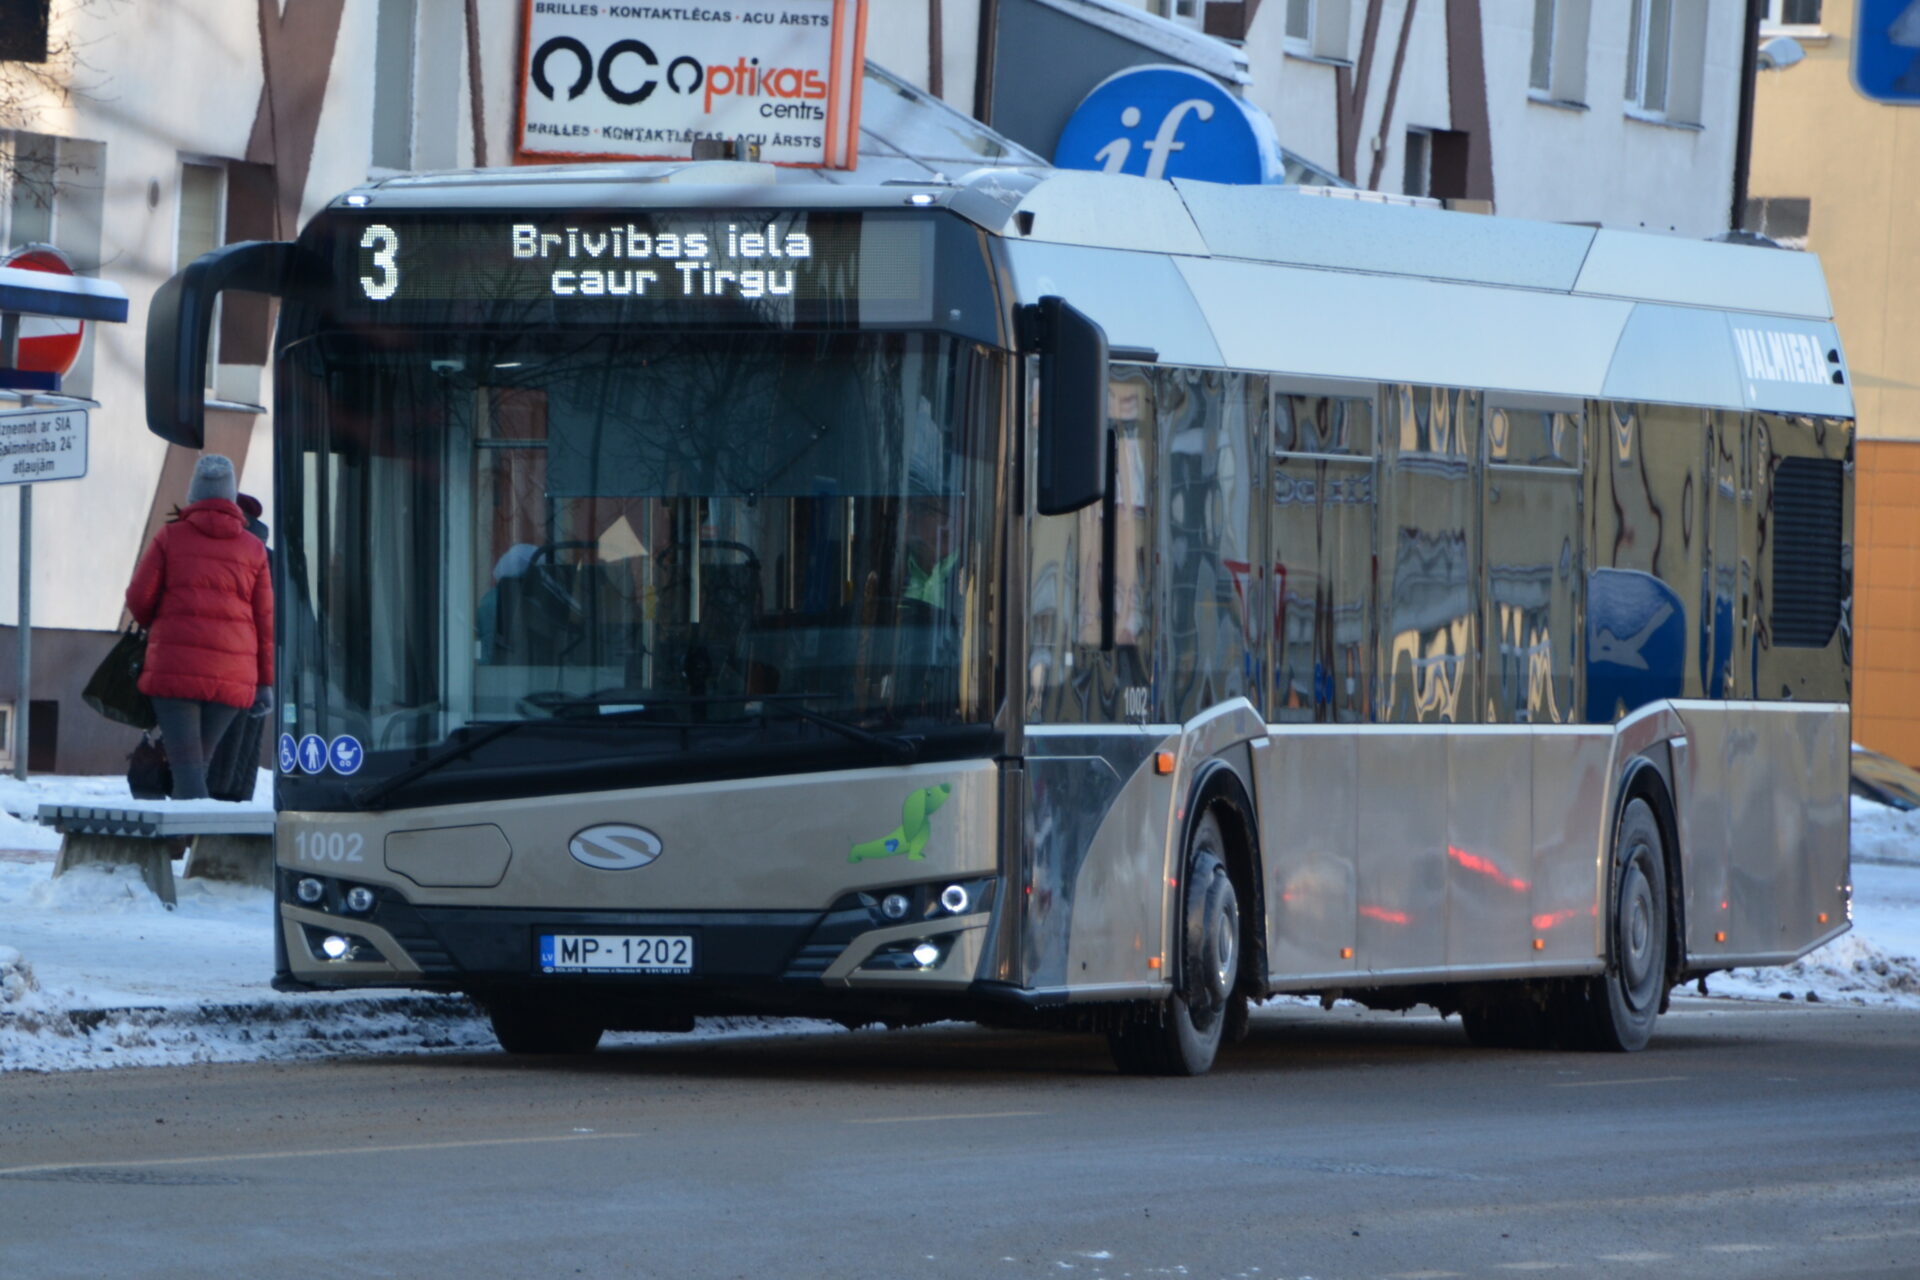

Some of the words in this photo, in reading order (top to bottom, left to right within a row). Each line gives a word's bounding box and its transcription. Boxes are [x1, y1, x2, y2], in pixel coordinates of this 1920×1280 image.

[535, 2, 598, 16] BRILLES
[743, 13, 774, 24] ACU
[779, 12, 829, 27] ĀRSTS
[759, 101, 824, 120] centrs
[527, 122, 590, 136] BRILLES
[1094, 98, 1215, 181] if
[512, 224, 708, 258] Brīvības
[728, 224, 810, 258] iela
[360, 224, 398, 300] 3
[551, 270, 658, 295] caur
[674, 261, 793, 298] Tirgu
[1733, 327, 1831, 386] VALMIERA
[55, 416, 72, 431] SIA
[1124, 687, 1147, 716] 1002
[295, 831, 364, 862] 1002
[542, 953, 553, 961] LV
